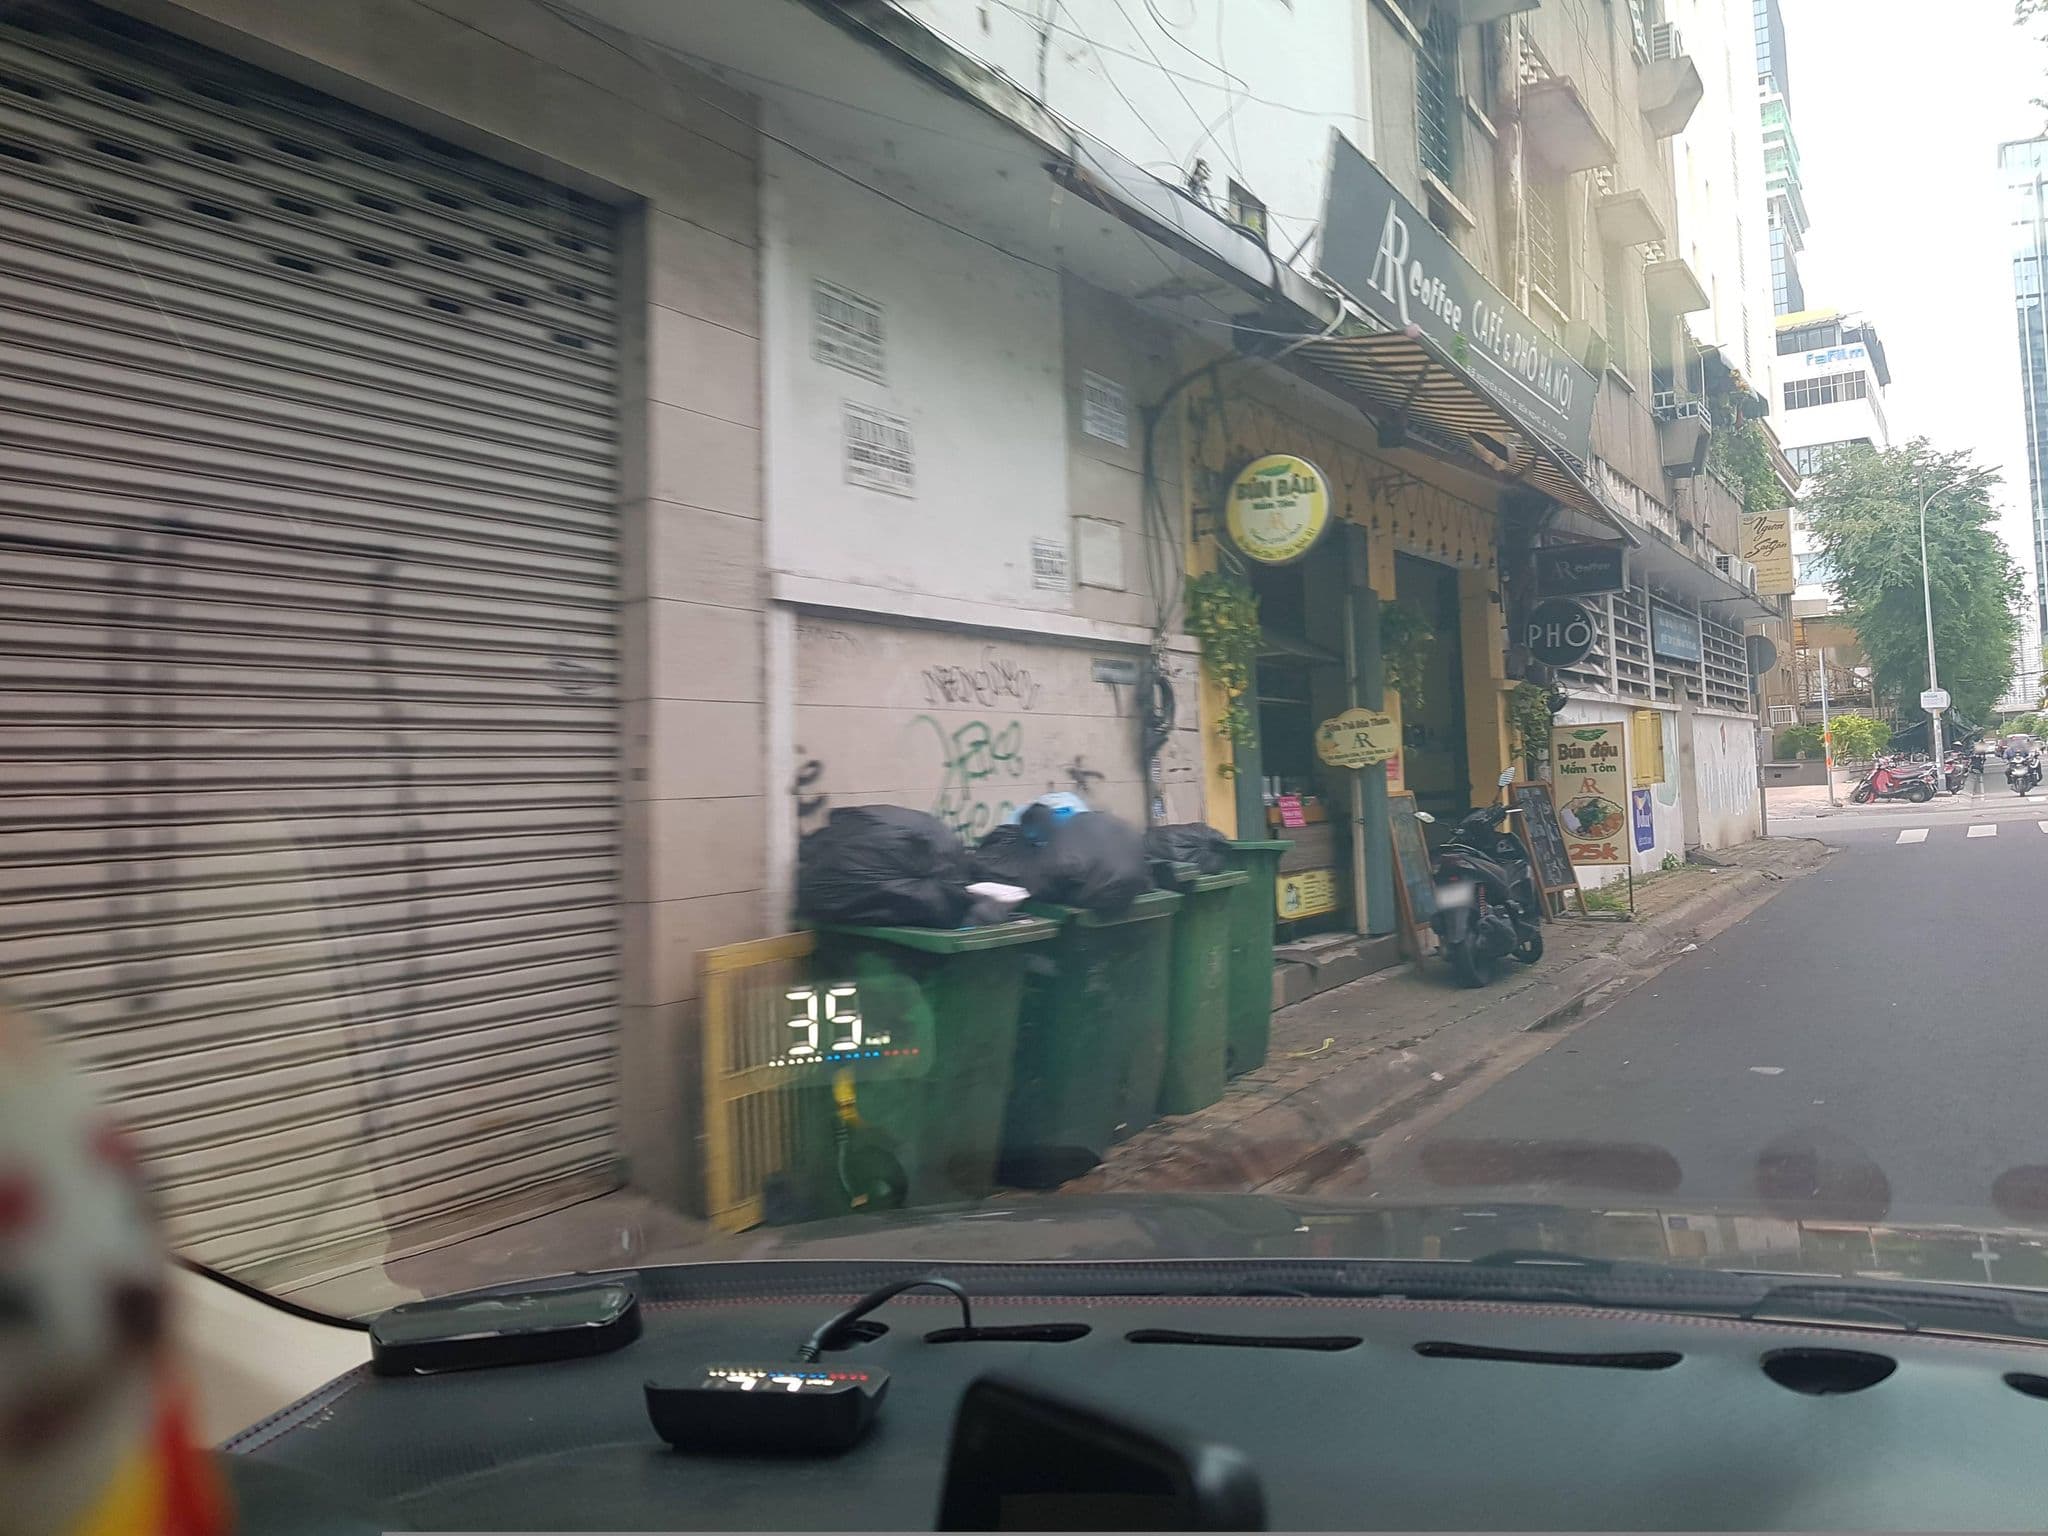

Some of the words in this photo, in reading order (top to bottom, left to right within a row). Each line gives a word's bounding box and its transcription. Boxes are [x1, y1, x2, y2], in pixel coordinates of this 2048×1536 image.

[1528, 614, 1591, 648] PHỞ
[1557, 742, 1586, 761] Bún
[1590, 741, 1618, 762] đậu
[785, 987, 862, 1055] 35
